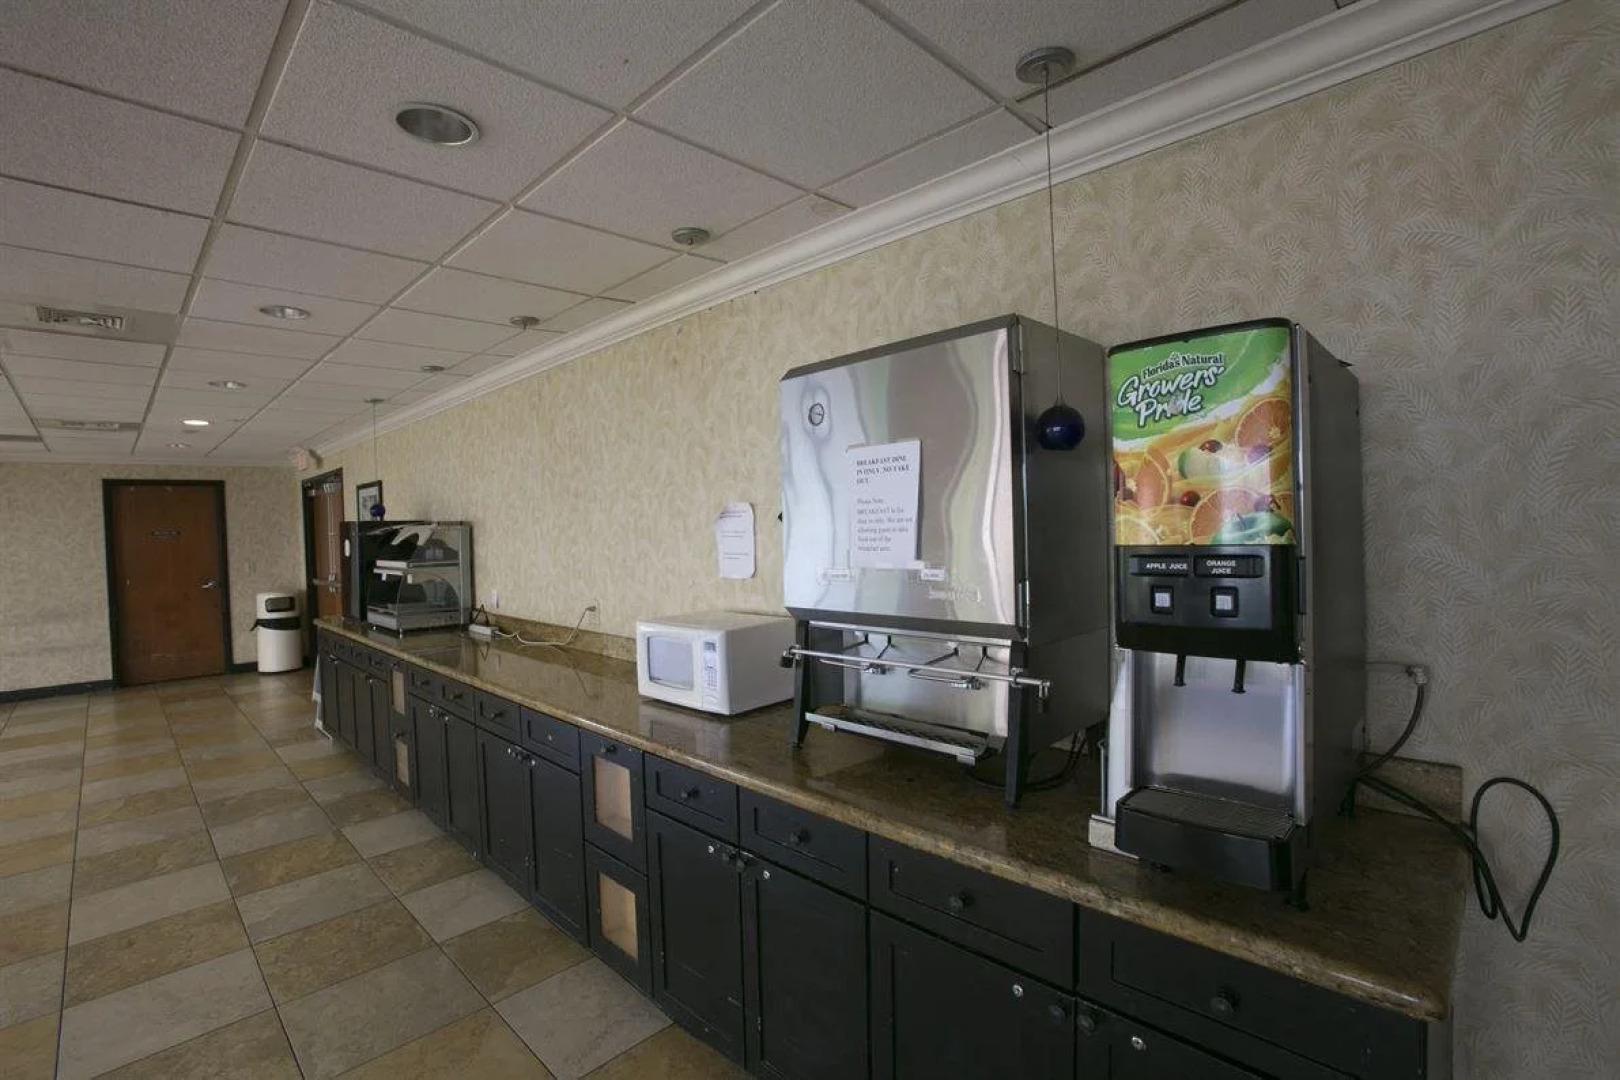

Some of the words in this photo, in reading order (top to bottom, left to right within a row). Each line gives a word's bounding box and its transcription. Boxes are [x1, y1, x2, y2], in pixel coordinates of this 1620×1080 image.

[1181, 354, 1224, 365] Natural
[1145, 562, 1167, 570] APPLE
[1169, 562, 1189, 570] JUICE
[1206, 559, 1236, 567] ORANGE
[1211, 567, 1232, 575] JUICE
